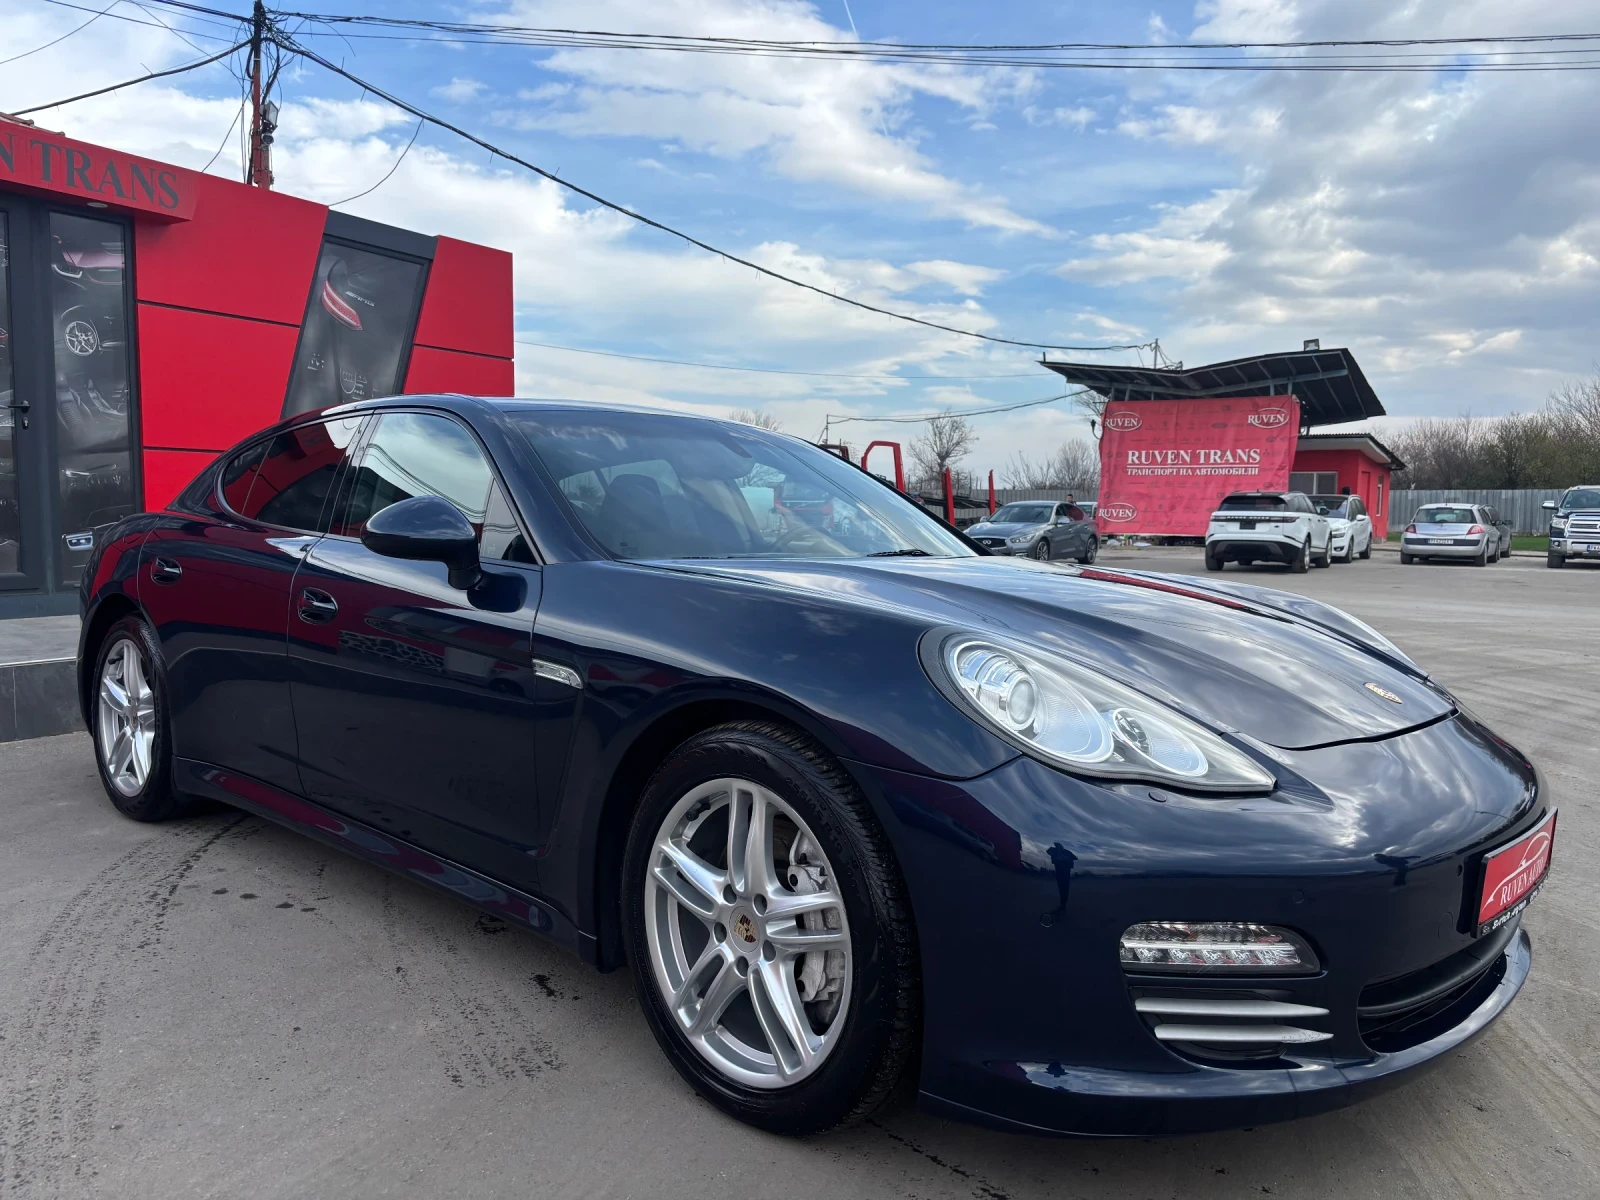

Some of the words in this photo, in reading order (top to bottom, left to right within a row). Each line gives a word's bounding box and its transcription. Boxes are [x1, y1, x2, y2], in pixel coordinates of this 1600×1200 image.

[30, 139, 180, 209] TRANS
[1105, 417, 1138, 427] RUVEN
[1247, 413, 1285, 424] RUVEN
[1127, 449, 1192, 465] RUVEN
[1196, 448, 1261, 464] TRANS
[1126, 468, 1178, 476] ТРАНСПОРТ
[1179, 468, 1192, 476] НА
[1194, 467, 1259, 476] АВТОМОБИЛИ
[1099, 507, 1133, 517] RUVEN
[1500, 869, 1529, 906] RUVEN
